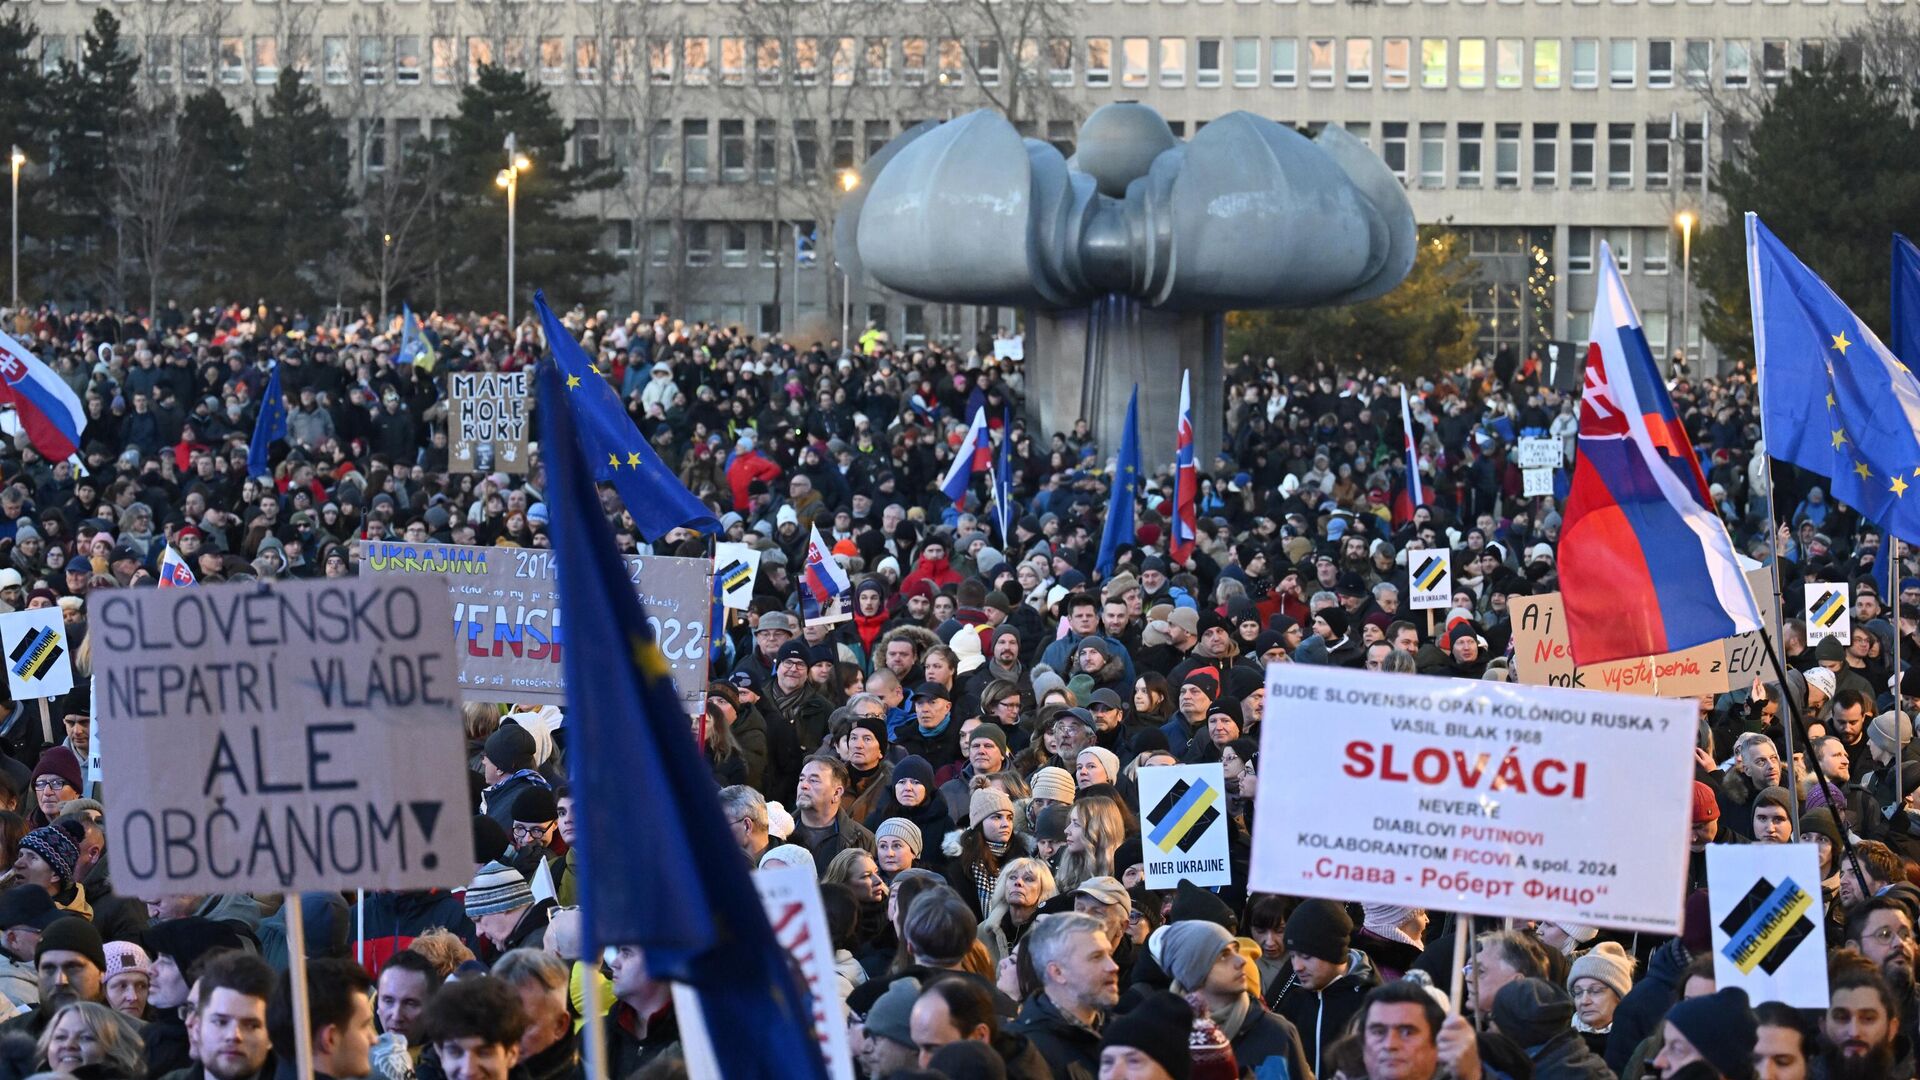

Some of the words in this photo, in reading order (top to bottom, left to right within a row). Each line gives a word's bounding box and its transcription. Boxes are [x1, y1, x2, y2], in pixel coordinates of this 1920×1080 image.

[462, 421, 523, 440] RUKY
[369, 544, 488, 575] UKRAJINA
[515, 551, 559, 580] 2014
[101, 587, 421, 652] SLOVENSKO
[17, 657, 34, 678] MIER
[31, 630, 57, 662] UKRAJINE
[1549, 667, 1586, 688] rok
[1710, 660, 1721, 673] z
[107, 652, 279, 718] NEPATRÍ
[311, 648, 453, 710] VLÁDE,
[1271, 683, 1319, 700] BUDE
[1325, 687, 1433, 712] SLOVENSKO
[1492, 703, 1586, 725] KOLÓNIOU
[1591, 711, 1653, 731] RUSKA
[1660, 719, 1670, 732] ?
[1391, 718, 1438, 736] VASIL
[1445, 723, 1498, 740] BILAK
[1505, 728, 1542, 744] 1968
[204, 723, 358, 796] ALE
[1342, 740, 1586, 799] SLOVÁCI
[1372, 816, 1456, 838] DIABLOVI
[1461, 825, 1544, 846] PUTINOVI
[1418, 798, 1501, 819] NEVERTE
[123, 797, 442, 880] OBČANOM!
[1297, 832, 1448, 860] KOLABORANTOM
[1453, 848, 1510, 867] FICOVI
[1515, 854, 1527, 868] A
[1532, 856, 1572, 874] spol.
[1578, 860, 1617, 876] 2024
[1149, 861, 1174, 875] MIER
[1176, 859, 1224, 873] UKRAJINE
[1302, 857, 1395, 885] „Слава
[1421, 867, 1515, 898] Роберт
[1523, 878, 1608, 905] Фицо“
[1730, 935, 1761, 966] MIER
[1755, 884, 1805, 940] UKRAJINE
